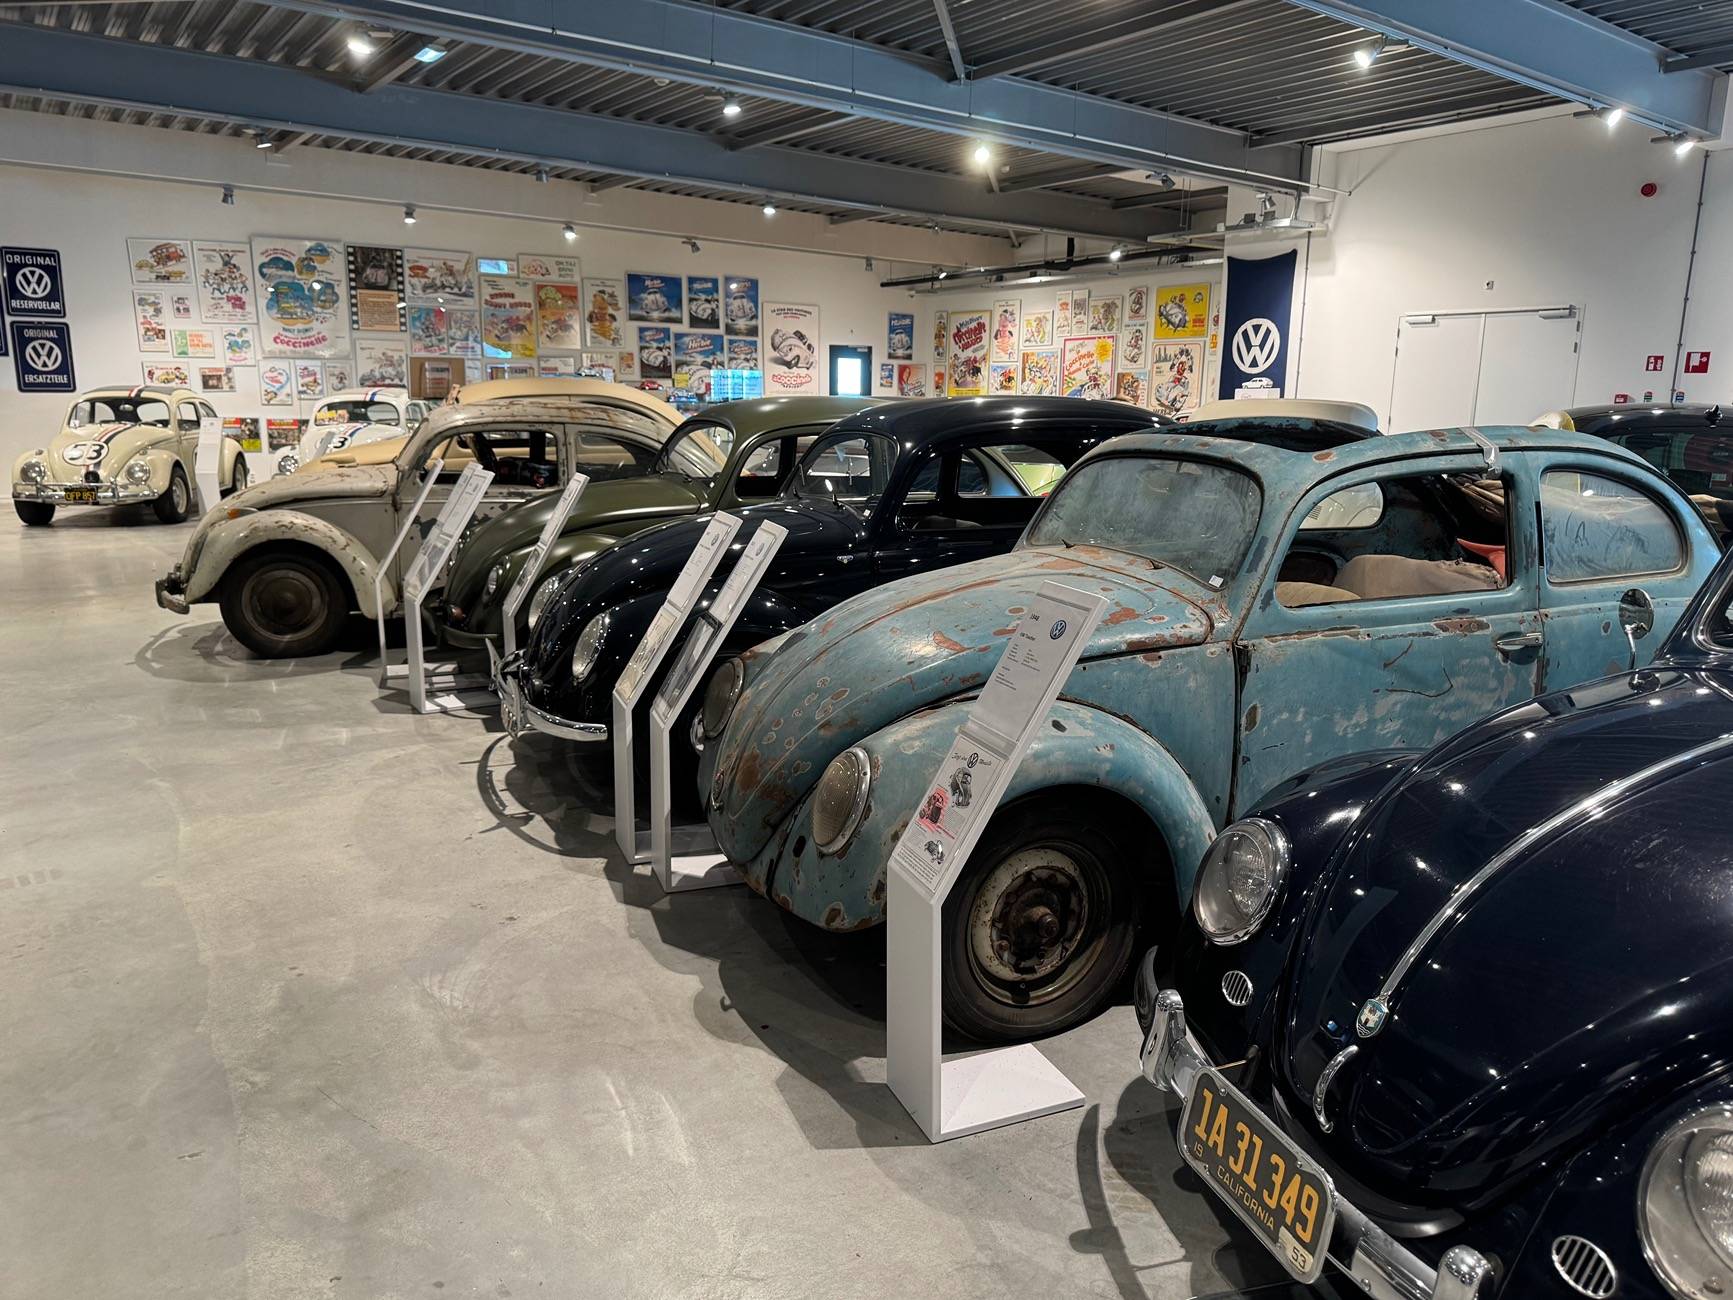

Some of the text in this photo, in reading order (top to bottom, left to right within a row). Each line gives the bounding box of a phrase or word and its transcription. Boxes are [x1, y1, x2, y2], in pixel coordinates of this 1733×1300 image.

[6, 254, 56, 266] ORIGINAL
[11, 299, 61, 311] RESERVDELAR
[23, 329, 58, 338] ORIGINAL
[272, 334, 328, 348] Coccinelle
[1232, 318, 1280, 374] VW
[24, 374, 68, 384] ERSATZTEILE
[69, 443, 105, 460] 53
[1195, 1088, 1319, 1243] 1A 31 349
[1217, 1164, 1274, 1230] CALIFORNIA
[1291, 1245, 1308, 1270] 53
